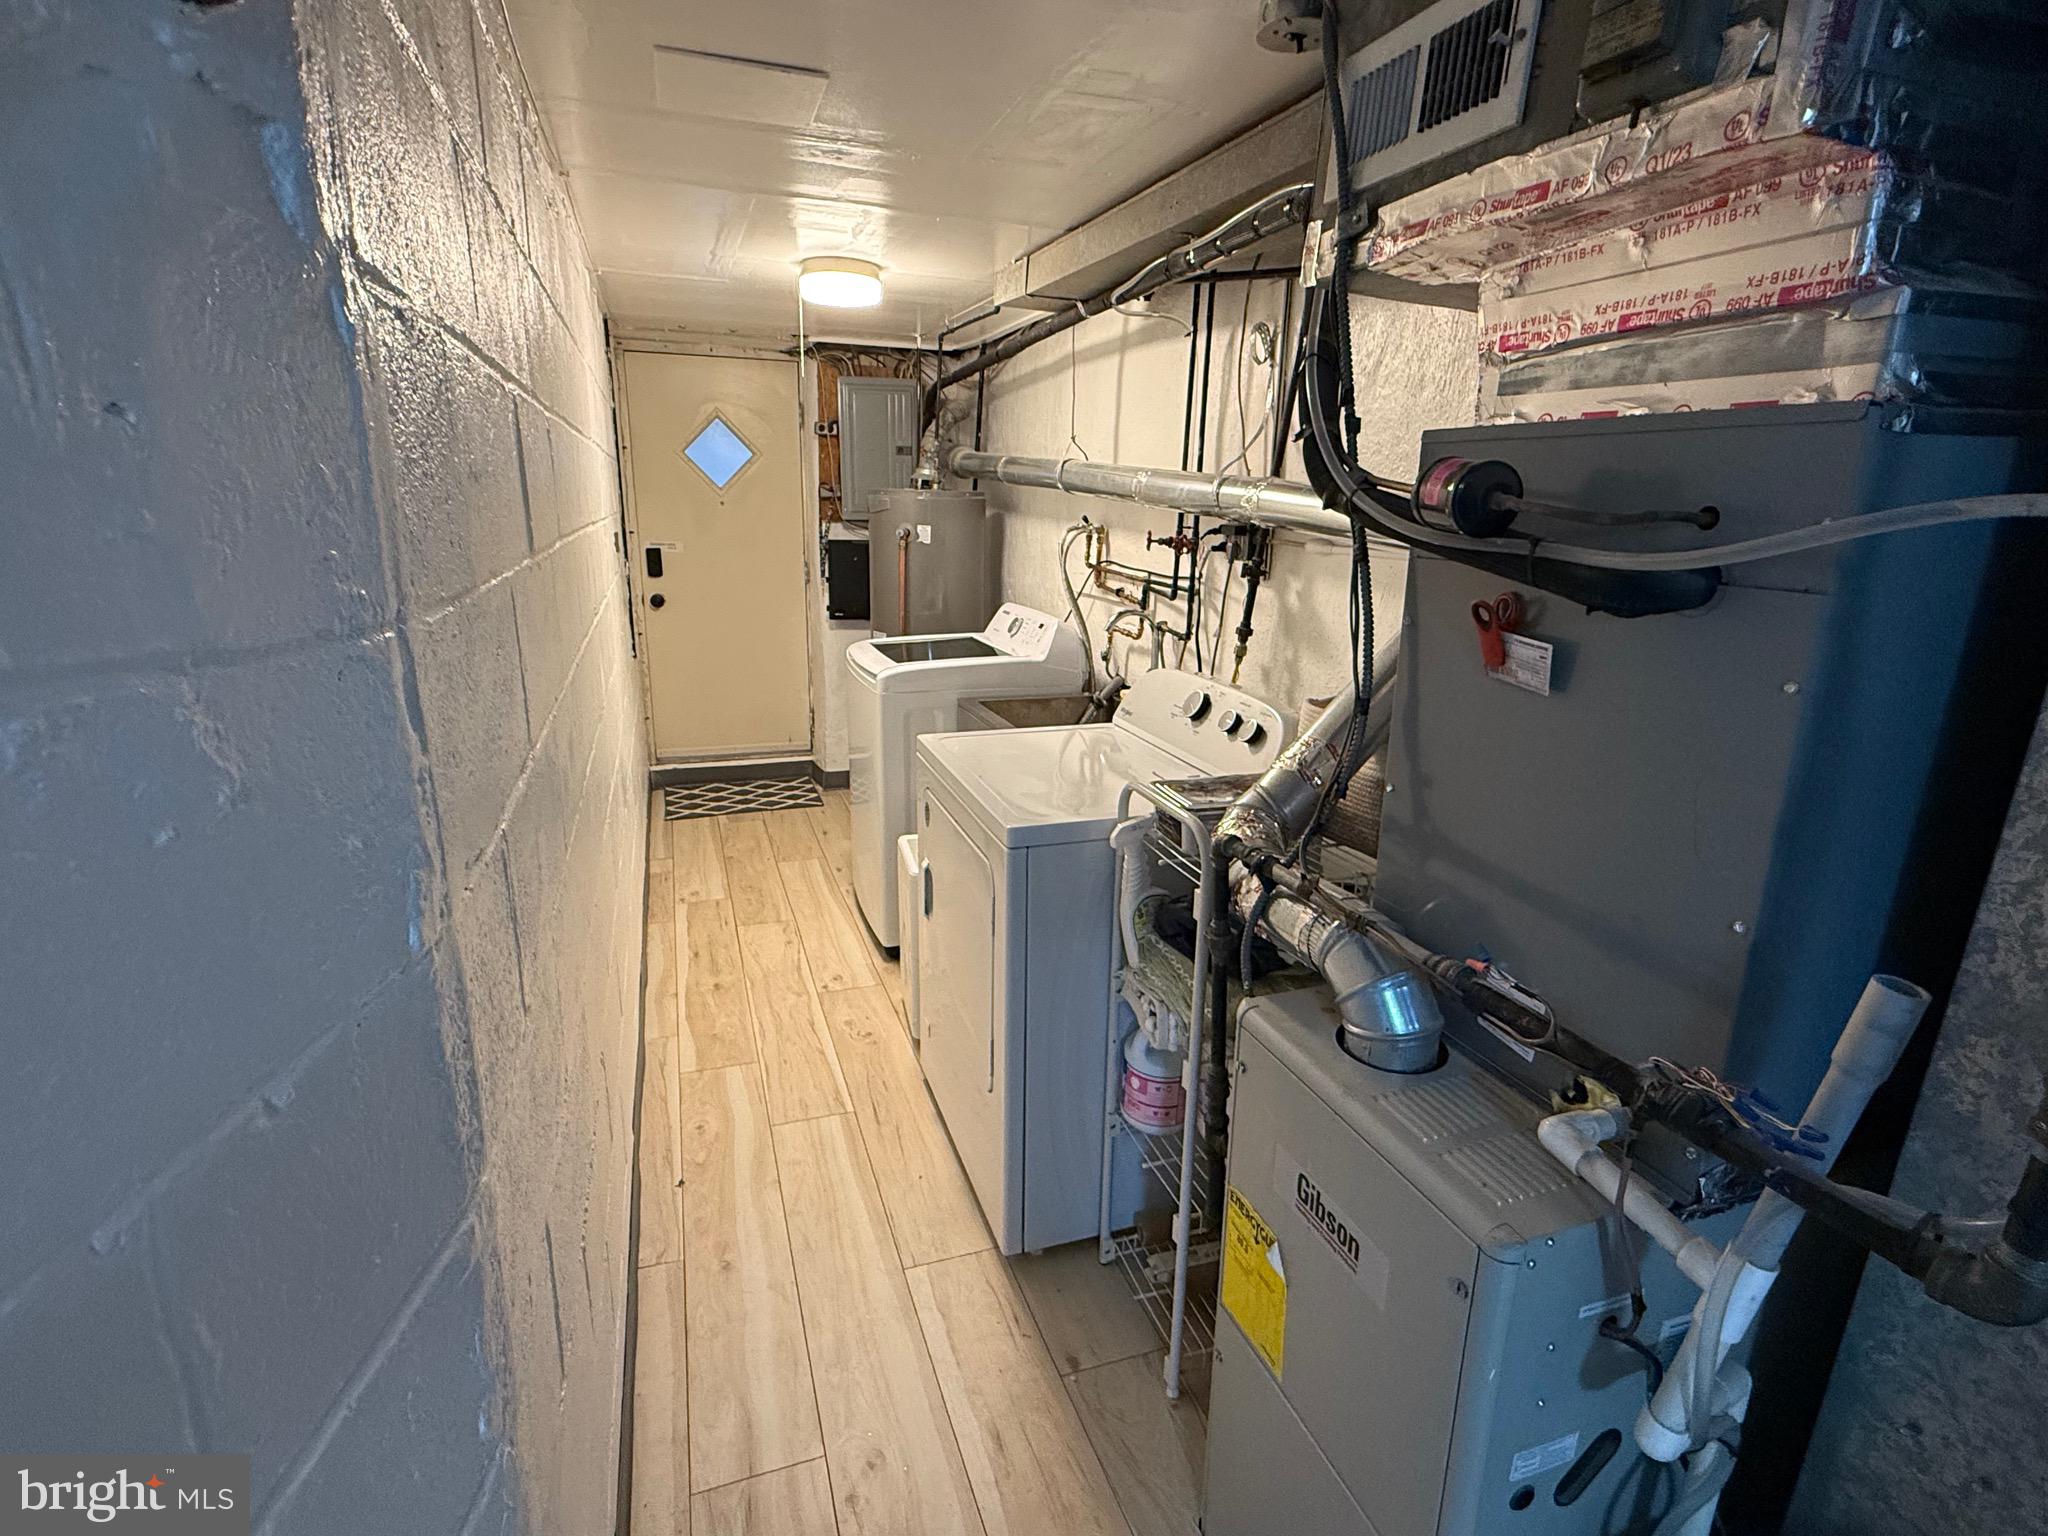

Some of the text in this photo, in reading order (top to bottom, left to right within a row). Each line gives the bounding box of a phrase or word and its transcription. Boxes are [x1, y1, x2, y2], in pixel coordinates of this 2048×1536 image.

[1645, 141, 1693, 175] Q1/23
[1489, 189, 1539, 214] Shurtape
[1551, 177, 1569, 197] AF
[1732, 187, 1753, 203] AF
[1653, 221, 1695, 242] 181A-P
[1707, 202, 1763, 229] 181B-FX
[1561, 243, 1606, 263] 181B-FX
[1746, 265, 1806, 290] 181B-FX
[1594, 296, 1637, 317] 181B-FX
[1648, 287, 1690, 307] 181A-P
[1725, 297, 1751, 314] 099
[1754, 290, 1776, 307] AF
[1520, 312, 1554, 331] 181A-P
[1599, 318, 1616, 333] AF
[1629, 307, 1687, 328] Shurtape
[1507, 328, 1552, 348] Shurtape
[1580, 320, 1599, 336] 099
[1297, 1172, 1360, 1262] Gibson
